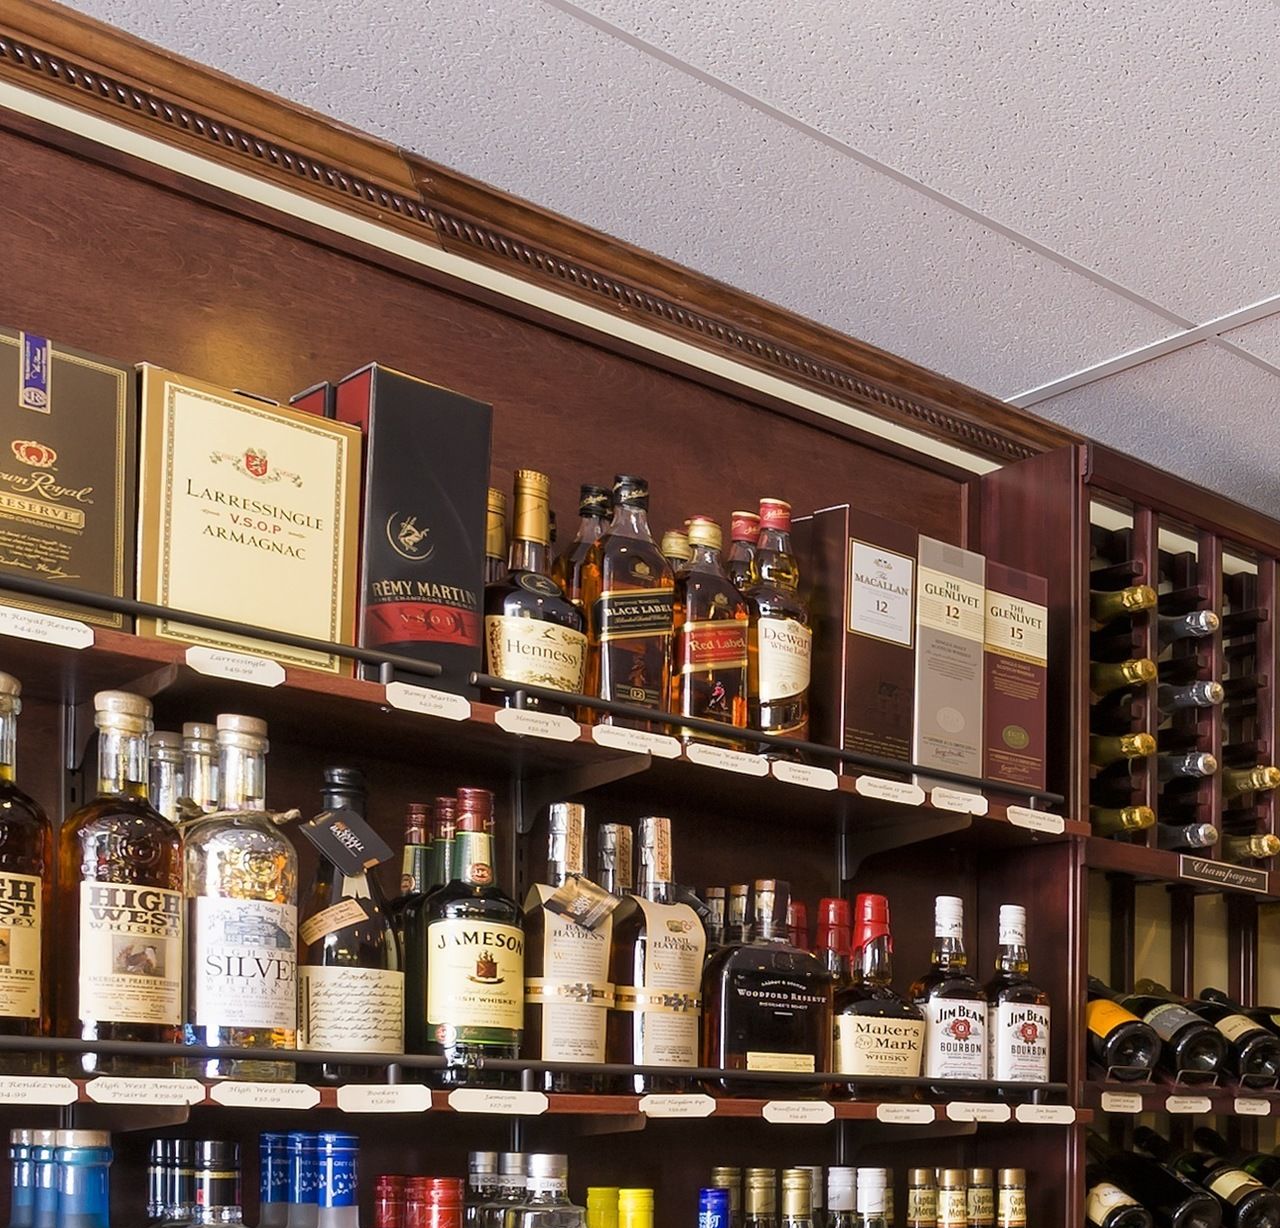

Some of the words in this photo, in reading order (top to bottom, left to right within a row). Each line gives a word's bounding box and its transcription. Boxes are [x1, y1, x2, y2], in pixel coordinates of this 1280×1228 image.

[11, 471, 94, 504] Royal
[186, 478, 324, 532] LARRESSINGLE
[229, 513, 283, 535] V.S.O.P
[202, 524, 307, 561] ARMAGNAC
[854, 572, 909, 597] MACALLAN
[944, 581, 961, 593] THE
[416, 581, 478, 605] MARTIN
[924, 583, 980, 609] GLENLIVET
[604, 605, 639, 617] BLACK
[640, 603, 673, 614] LABEL
[874, 599, 889, 614] 12
[944, 605, 961, 620] 12
[1009, 603, 1026, 615] THE
[990, 605, 1043, 631] GLENLIVET
[1009, 627, 1024, 641] 15
[689, 640, 714, 651] Red
[716, 637, 747, 649] Label
[506, 638, 579, 668] Hennessy
[1191, 860, 1258, 885] Champagne
[89, 885, 181, 914] HIGH
[89, 907, 181, 928] WEST
[89, 922, 180, 937] WHISKEY
[437, 930, 524, 956] JAMESON
[479, 997, 517, 1006] WHISKEY
[737, 987, 789, 1000] WOODFORD
[936, 1007, 956, 1024] JIM
[958, 1005, 985, 1026] BEAM
[1007, 1011, 1026, 1028] JIM
[855, 1022, 920, 1038] Maker's
[875, 1037, 918, 1051] Mark
[940, 1042, 982, 1053] BOURBON
[1010, 1045, 1047, 1056] BOURBON
[865, 1053, 909, 1062] WHISKY
